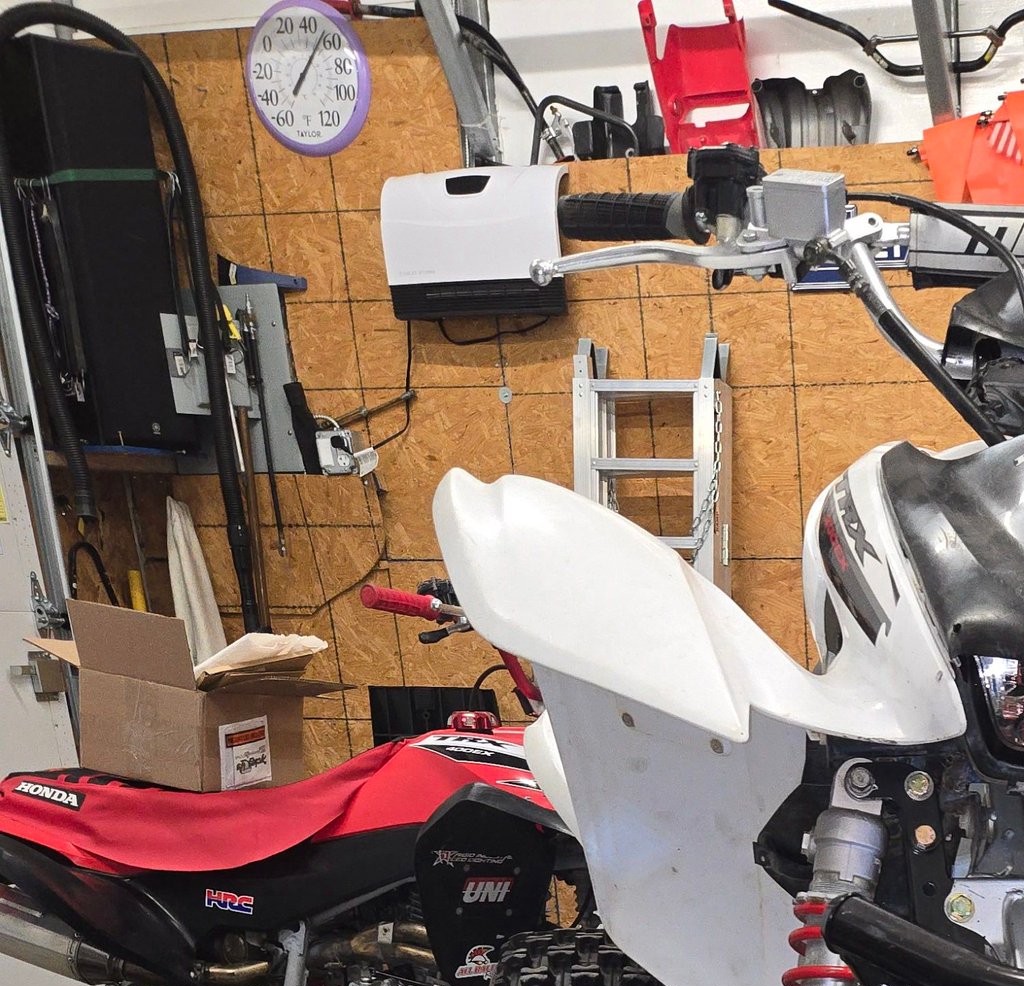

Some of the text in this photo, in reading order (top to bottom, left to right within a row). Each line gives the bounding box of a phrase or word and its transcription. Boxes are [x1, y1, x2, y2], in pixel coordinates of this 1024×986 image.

[276, 17, 294, 34] 20
[299, 16, 318, 34] 40
[262, 36, 272, 52] 0
[323, 33, 341, 50] 60
[253, 63, 273, 80] -20
[334, 58, 352, 75] 80
[258, 89, 279, 106] -40
[335, 84, 356, 101] 100
[271, 110, 294, 127] -60
[319, 110, 341, 127] 120
[296, 130, 321, 138] TAYLOR
[432, 735, 508, 750] TRX
[445, 746, 495, 757] 400EX
[15, 781, 80, 808] HONDA
[462, 881, 511, 904] UNI
[205, 888, 254, 915] HRC
